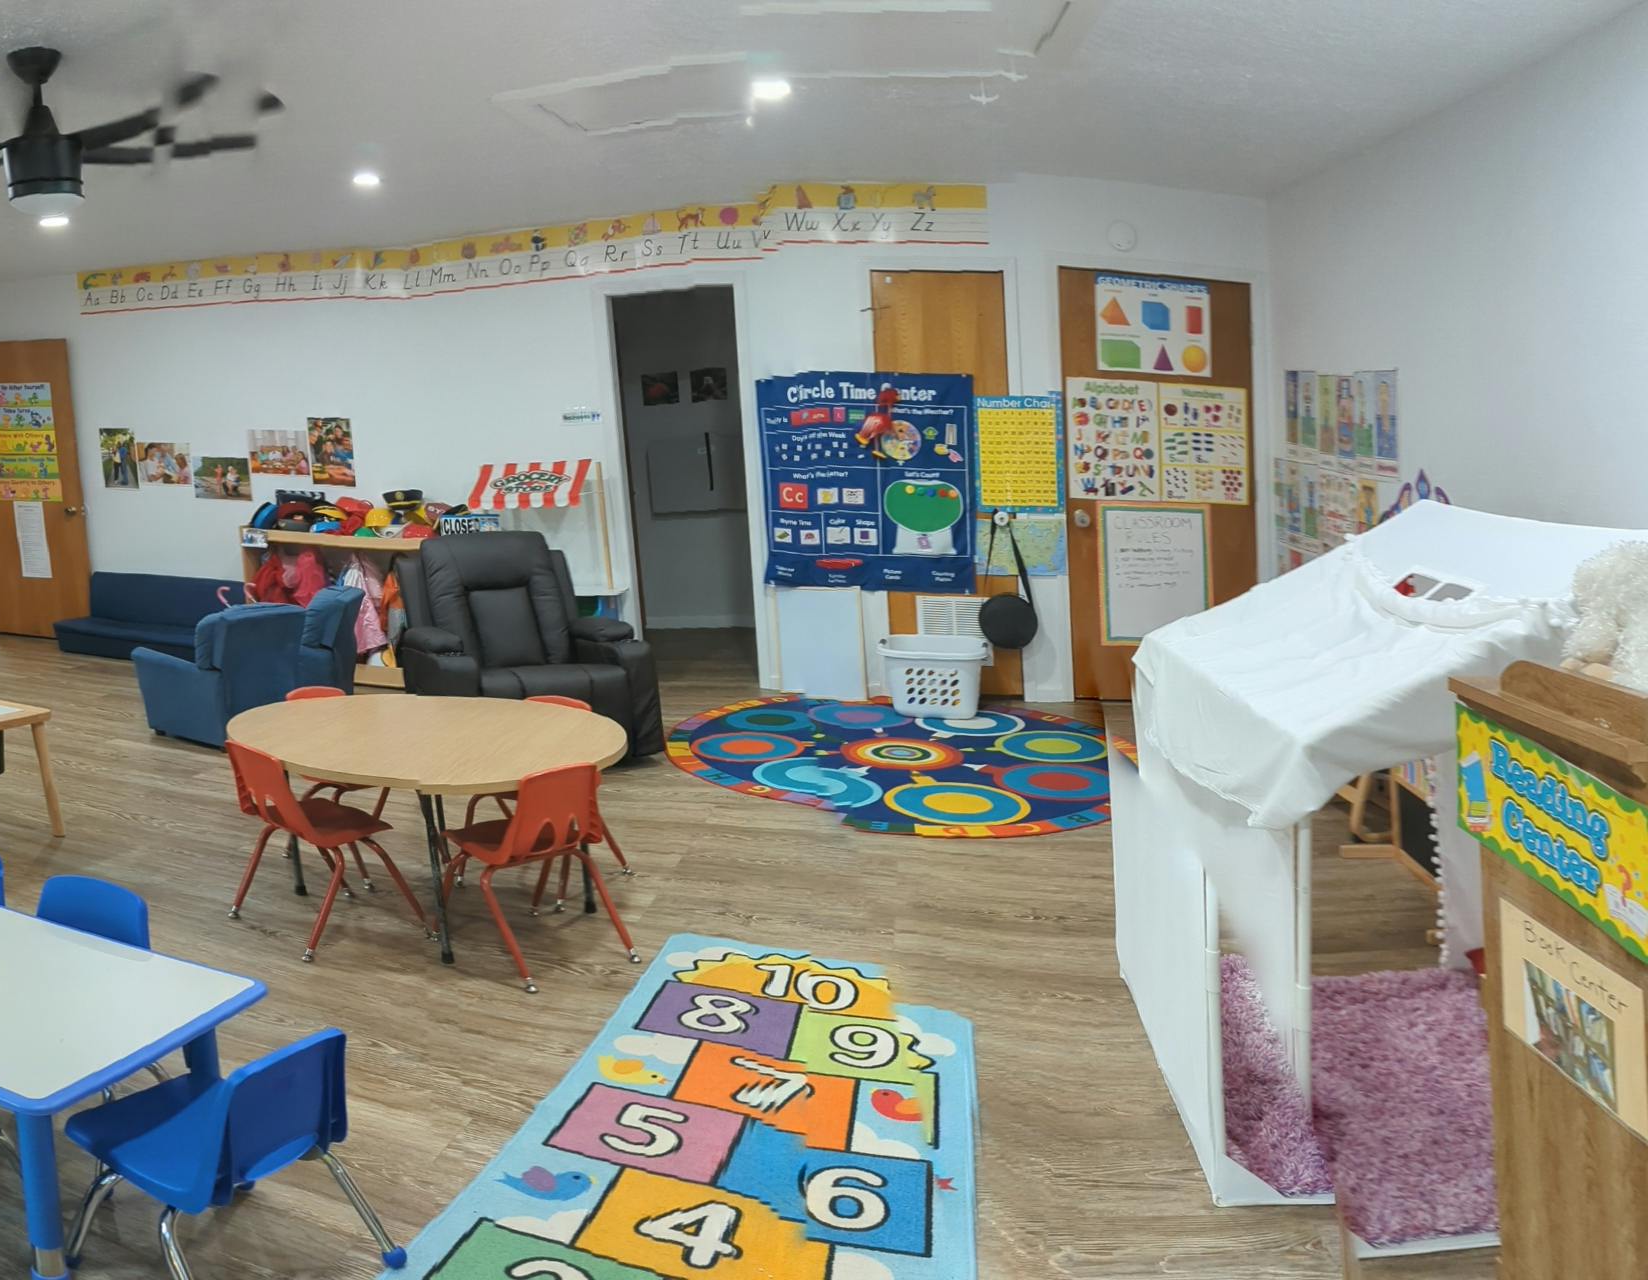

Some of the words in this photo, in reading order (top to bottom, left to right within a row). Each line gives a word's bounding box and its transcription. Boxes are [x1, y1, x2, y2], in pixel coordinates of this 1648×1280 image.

[84, 291, 100, 306] Aa
[109, 289, 127, 304] Bb
[136, 287, 153, 302] Cc
[160, 285, 179, 300] Dd
[187, 282, 204, 298] Ee
[214, 279, 233, 295] Ff
[243, 278, 261, 298] Gg
[275, 276, 297, 293] Hh
[311, 274, 323, 291] Ii
[332, 274, 349, 295] Jj
[365, 273, 388, 290] Kk
[403, 272, 420, 290] Ll
[429, 267, 456, 287] Mm
[466, 262, 489, 279] Nn
[499, 258, 522, 276] Oo
[529, 254, 551, 278] Pp
[604, 244, 628, 263] Rr
[641, 239, 663, 257] Ss
[678, 231, 700, 254] Tt
[716, 231, 742, 250] Uu
[784, 211, 820, 232] Ww
[832, 211, 862, 232] Xx
[871, 212, 892, 240] Yy
[910, 211, 936, 232] Zz
[786, 380, 835, 403] Circle
[839, 382, 877, 400] Time
[880, 383, 937, 401] nter
[977, 398, 1021, 408] Number
[1024, 398, 1055, 409] Char
[1084, 382, 1139, 395] Alphabet
[491, 472, 569, 489] GROCERY
[504, 484, 553, 493] STORE
[782, 487, 805, 504] Cc
[792, 471, 814, 480] What's
[1489, 738, 1611, 860] Reading
[1502, 796, 1603, 898] Center
[753, 961, 860, 1013] 10
[1522, 919, 1567, 966] Book
[1567, 958, 1631, 1012] Center
[677, 992, 760, 1035] 8
[830, 1025, 899, 1069] 9
[730, 1055, 812, 1113] 7
[600, 1102, 688, 1157] 5
[805, 1165, 889, 1231] 6
[635, 1200, 742, 1269] 4
